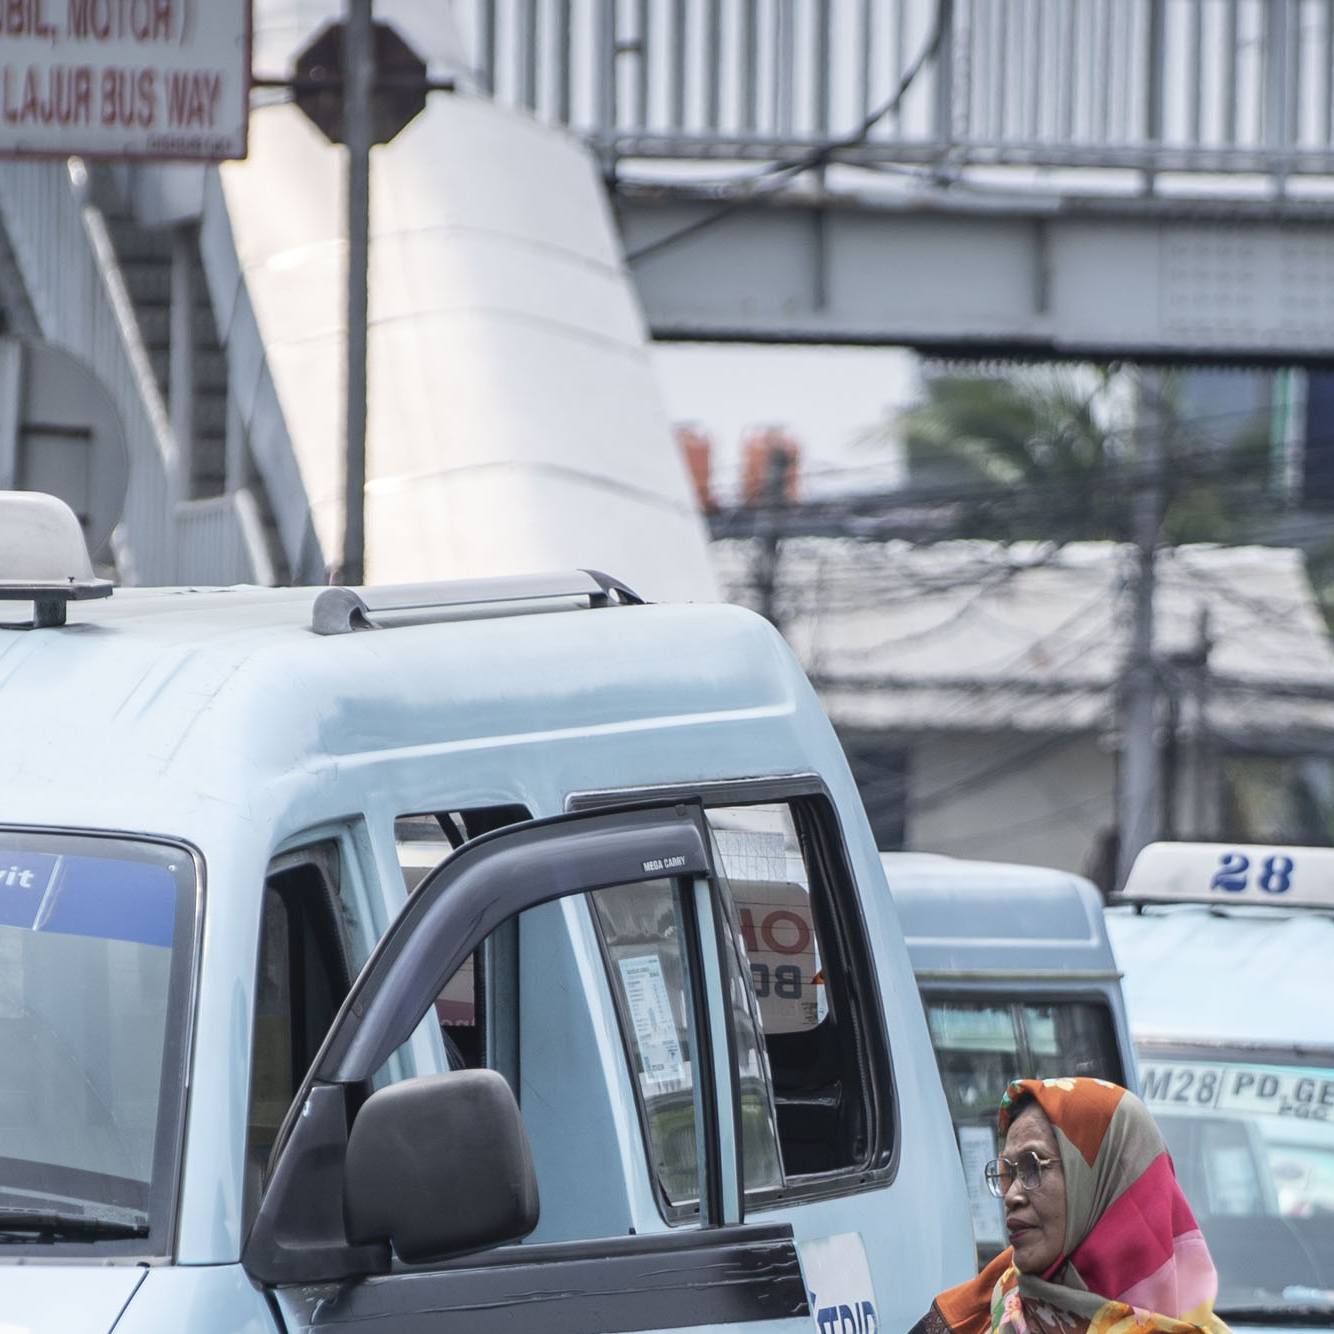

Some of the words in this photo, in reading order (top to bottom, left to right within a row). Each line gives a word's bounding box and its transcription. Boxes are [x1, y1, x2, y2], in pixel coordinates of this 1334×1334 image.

[2, 64, 93, 126] LAJUR
[100, 67, 155, 128] BUS
[165, 69, 227, 128] WAY
[642, 859, 663, 872] MEGA
[664, 855, 686, 869] CARRY
[1210, 853, 1294, 893] 28
[1142, 1067, 1217, 1105] M28
